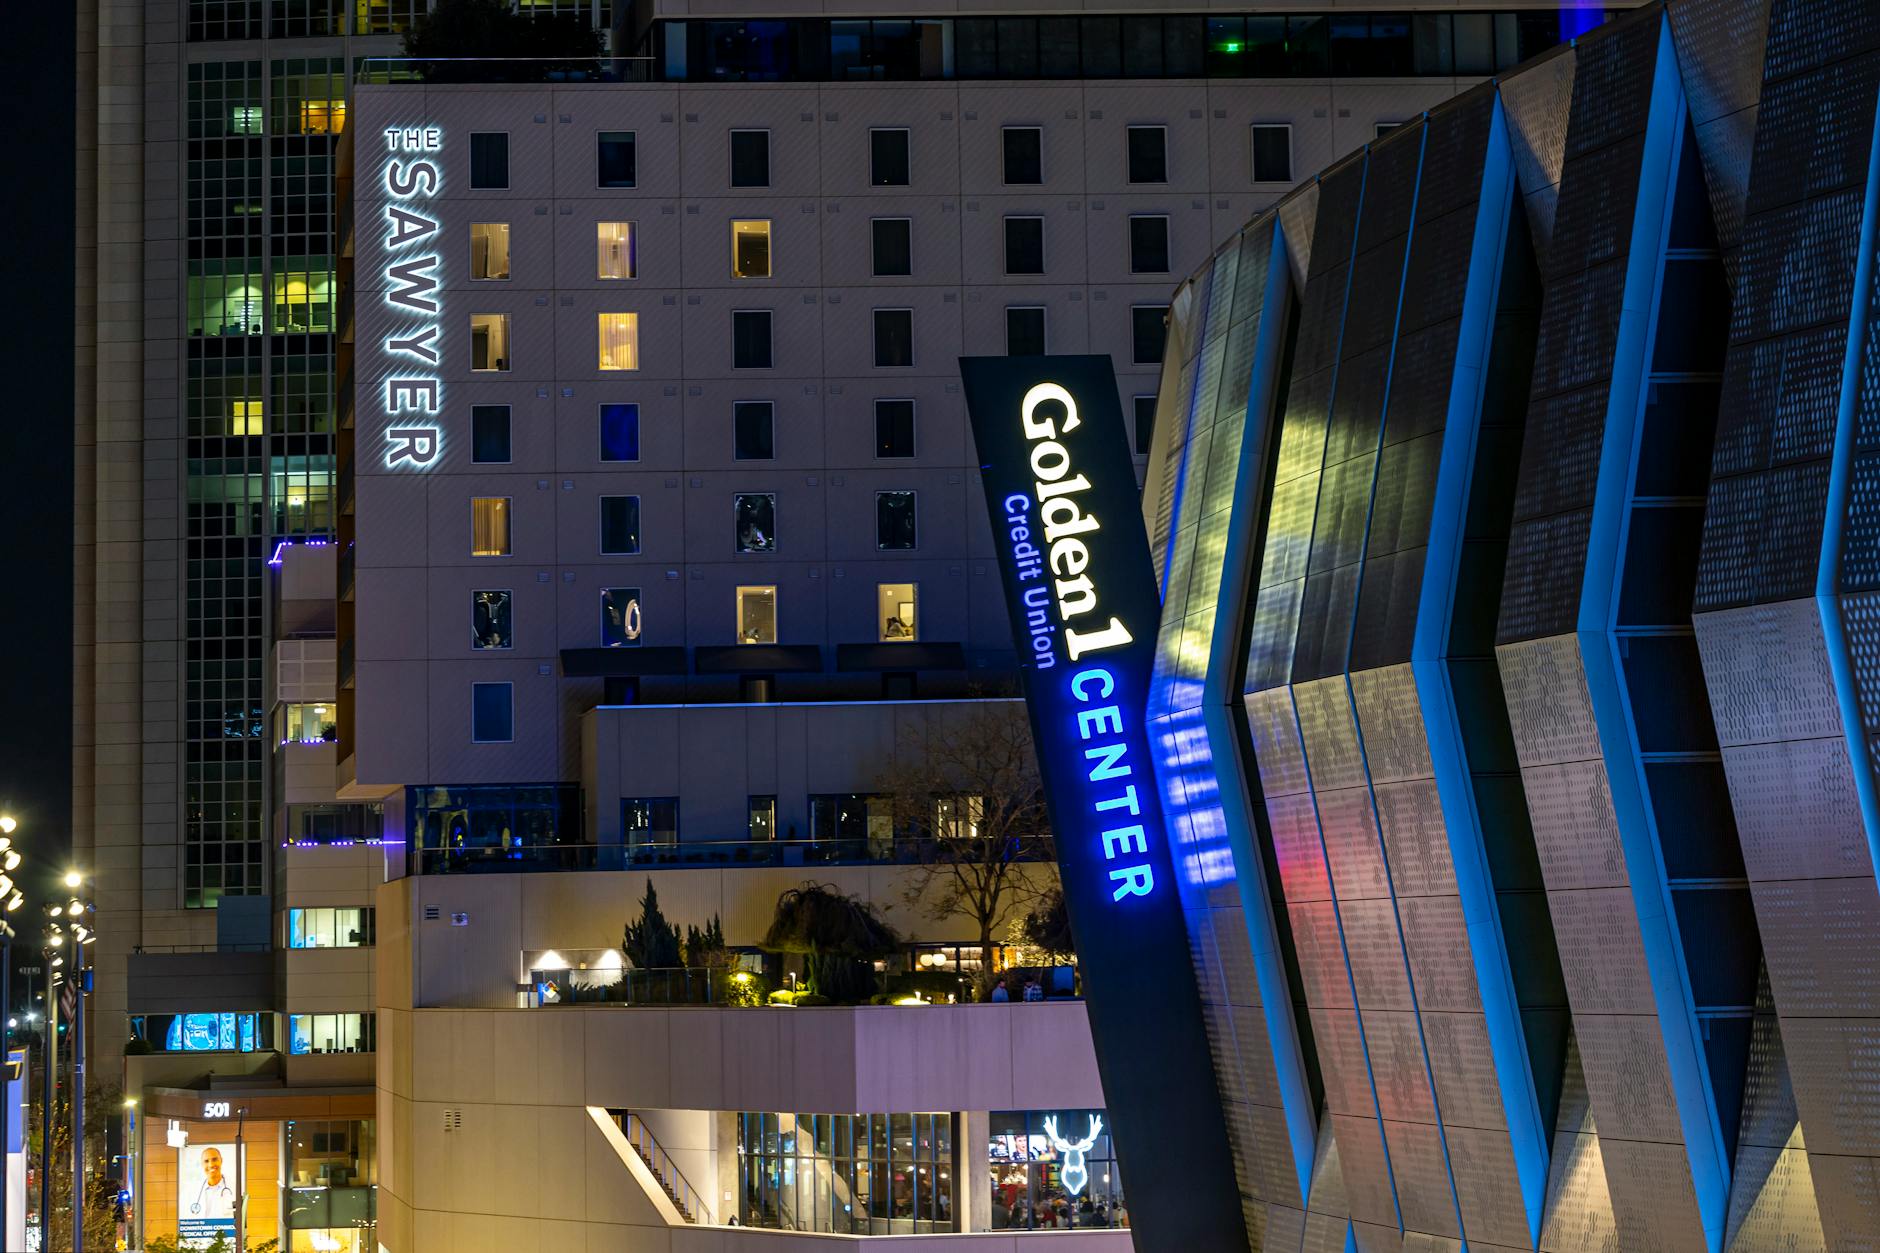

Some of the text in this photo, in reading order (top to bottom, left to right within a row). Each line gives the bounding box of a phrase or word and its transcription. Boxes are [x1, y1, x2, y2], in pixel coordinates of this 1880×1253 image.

[386, 128, 439, 149] THE
[387, 160, 439, 466] SAWYER
[1004, 494, 1057, 670] Credit Union
[1070, 668, 1155, 903] CENTER
[203, 1102, 230, 1118] 501
